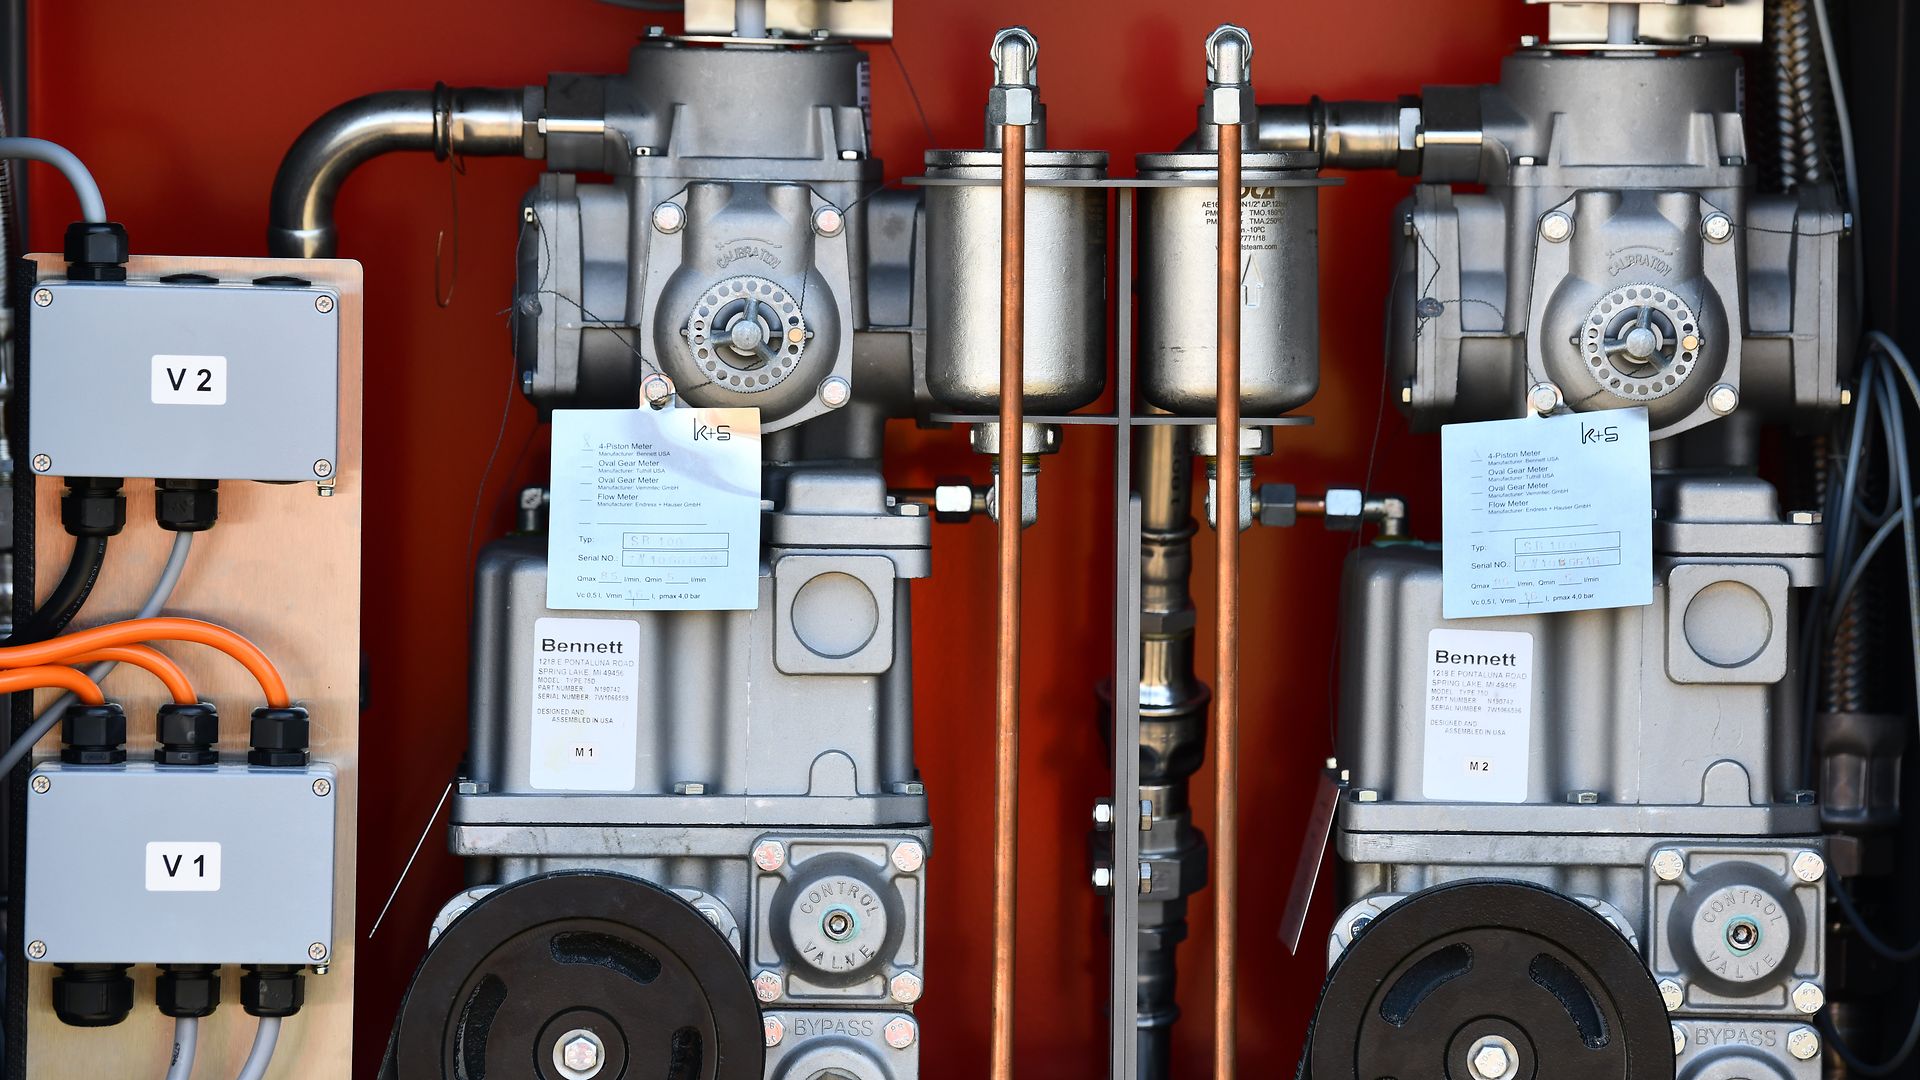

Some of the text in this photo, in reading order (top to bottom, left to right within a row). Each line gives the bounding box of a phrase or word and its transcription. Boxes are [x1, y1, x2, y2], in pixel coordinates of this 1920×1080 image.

[166, 367, 212, 392] V 2
[1488, 468, 1506, 476] Oval
[1506, 467, 1526, 475] Gear
[597, 476, 658, 484] Oval Gear Meter
[577, 554, 599, 562] Serial
[1471, 562, 1493, 570] Serial
[1538, 579, 1556, 587] Qmin
[542, 638, 624, 654] Bennett
[539, 658, 556, 666] 1218
[1435, 649, 1517, 667] Bennett
[551, 716, 591, 724] ASSEMBLED
[1463, 720, 1478, 728] AND
[575, 747, 594, 757] M 1
[1469, 761, 1490, 771] M 2
[162, 854, 205, 878] V 1
[800, 881, 879, 917] CONTROL
[1704, 890, 1784, 926] CONTROL
[803, 941, 874, 970] VALVE
[1706, 951, 1776, 978] VALVE
[794, 1018, 874, 1037] BYPASS
[1695, 1027, 1776, 1047] BYPASS
